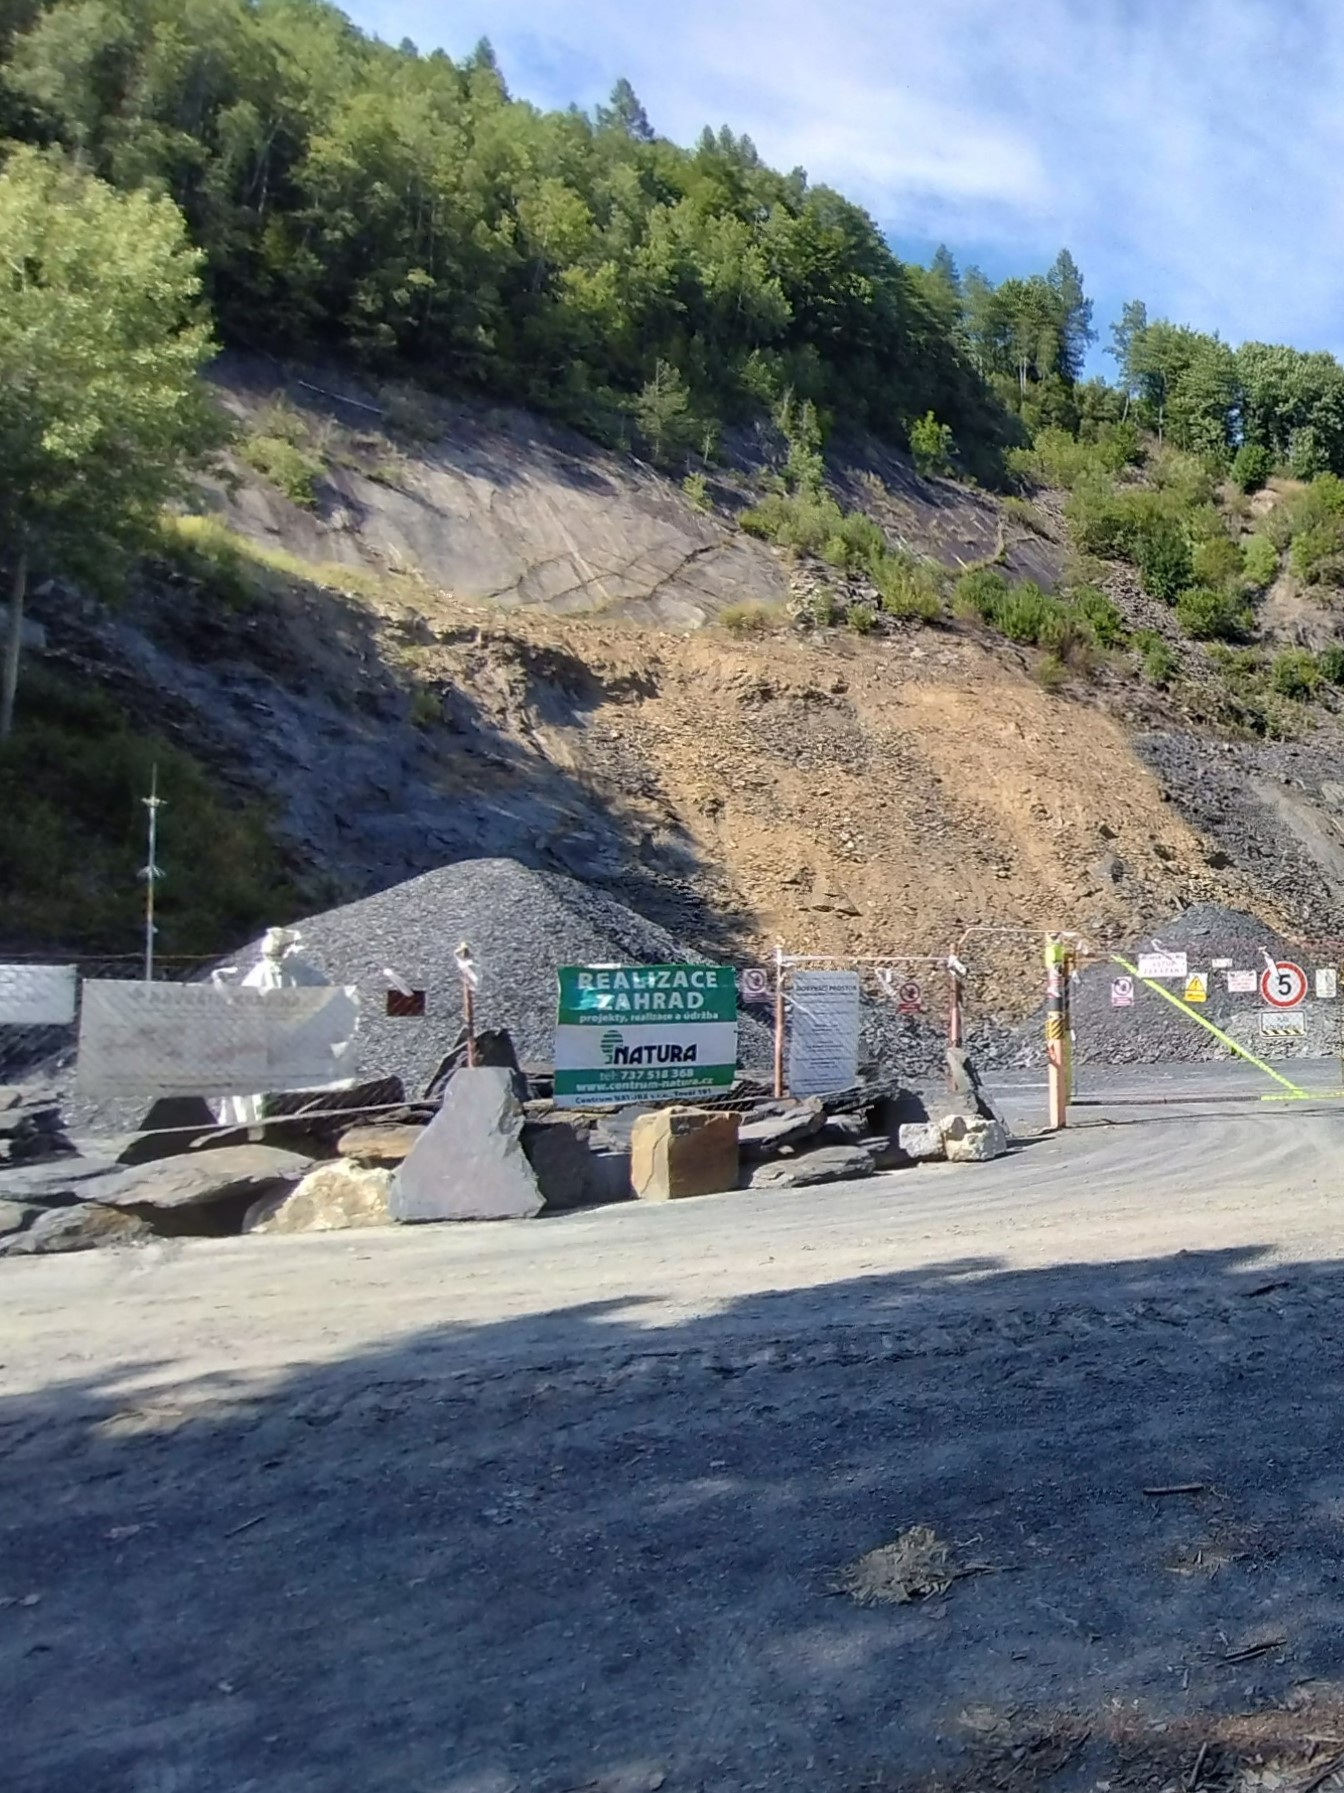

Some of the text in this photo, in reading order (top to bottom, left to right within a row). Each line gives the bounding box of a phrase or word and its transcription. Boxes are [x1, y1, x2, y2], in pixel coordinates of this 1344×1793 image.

[577, 970, 719, 990] REALIZACE
[1278, 974, 1292, 996] 5
[596, 991, 705, 1011] ZAHRAD
[579, 1012, 628, 1024] projekty,
[630, 1012, 673, 1021] realizace
[683, 1010, 719, 1020] údržba
[613, 1043, 698, 1065] NATURA
[620, 1070, 645, 1080] 737
[671, 1068, 694, 1078] 368
[576, 1077, 714, 1092] www.centrum-natura.cz
